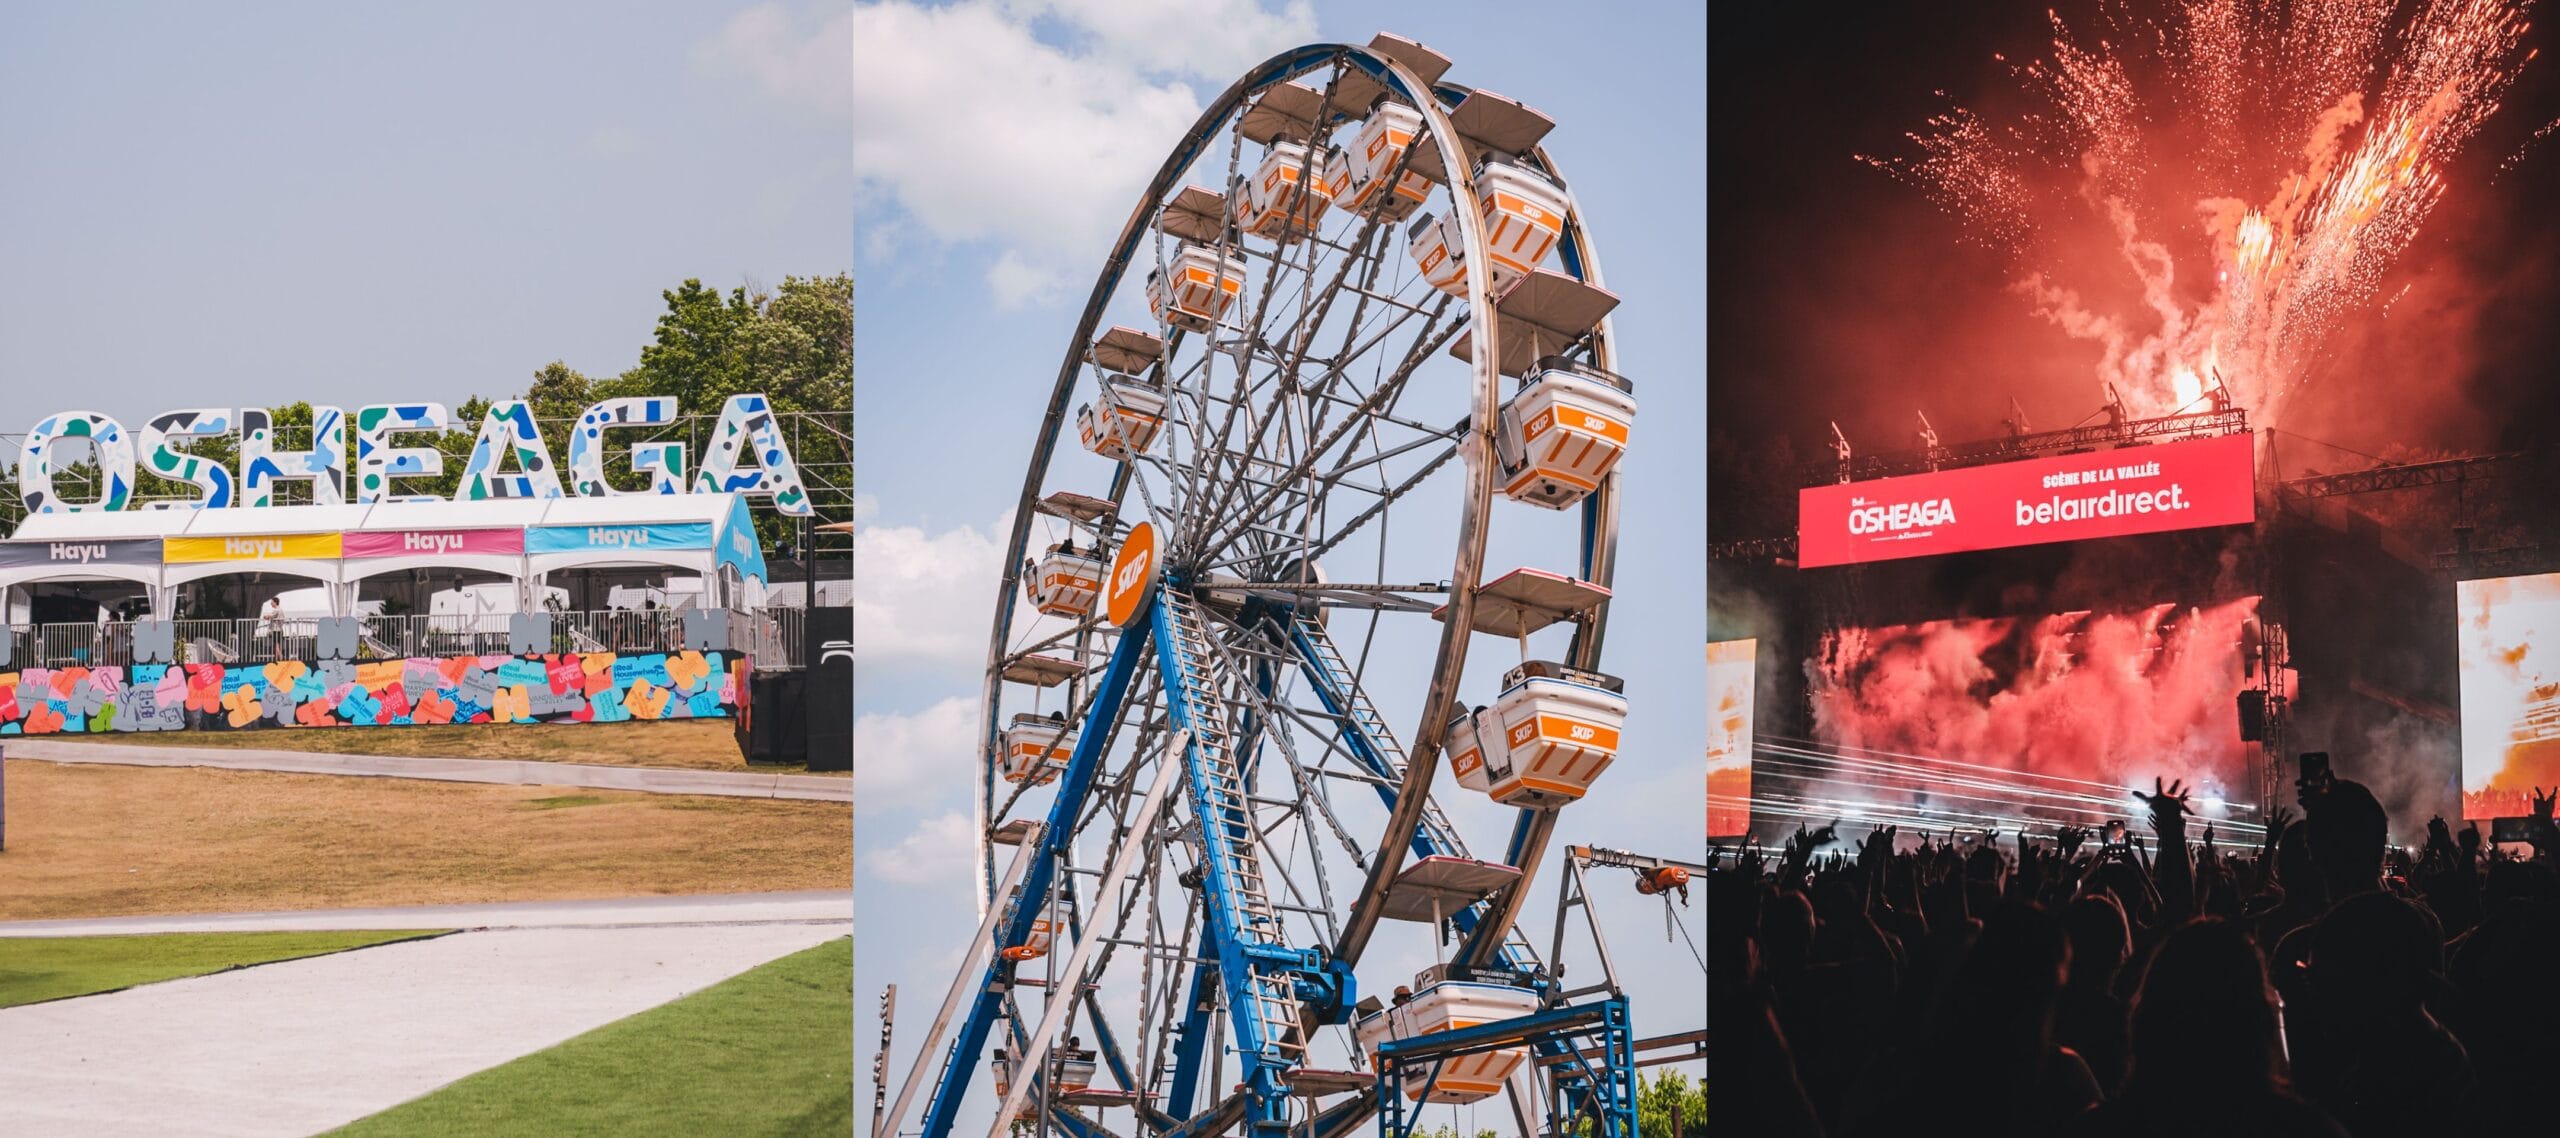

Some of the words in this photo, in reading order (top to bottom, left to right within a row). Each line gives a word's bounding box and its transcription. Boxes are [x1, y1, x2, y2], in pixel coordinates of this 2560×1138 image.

[1521, 204, 1543, 219] SKIP
[1426, 251, 1441, 269] SKIP
[1521, 362, 1542, 384] 14
[1531, 414, 1549, 437] SKIP
[1584, 416, 1606, 431] SKIP
[19, 393, 815, 516] OSHEAGA
[2043, 471, 2080, 488] SCÈNE
[2081, 470, 2097, 484] DE
[2099, 467, 2115, 482] LA
[2117, 461, 2160, 480] VALLÉE
[1848, 498, 1956, 535] OSHEAGA
[225, 536, 283, 560] Hayu
[404, 532, 464, 554] Hayu
[588, 527, 649, 549] Hayu
[733, 524, 752, 563] Hayu
[50, 543, 107, 564] Hayu
[1113, 549, 1149, 600] SKIP
[1505, 666, 1527, 687] 13
[1515, 723, 1533, 744] SKIP
[1570, 724, 1595, 740] SKIP
[1458, 754, 1474, 773] SKIP
[1417, 969, 1435, 989] 12
